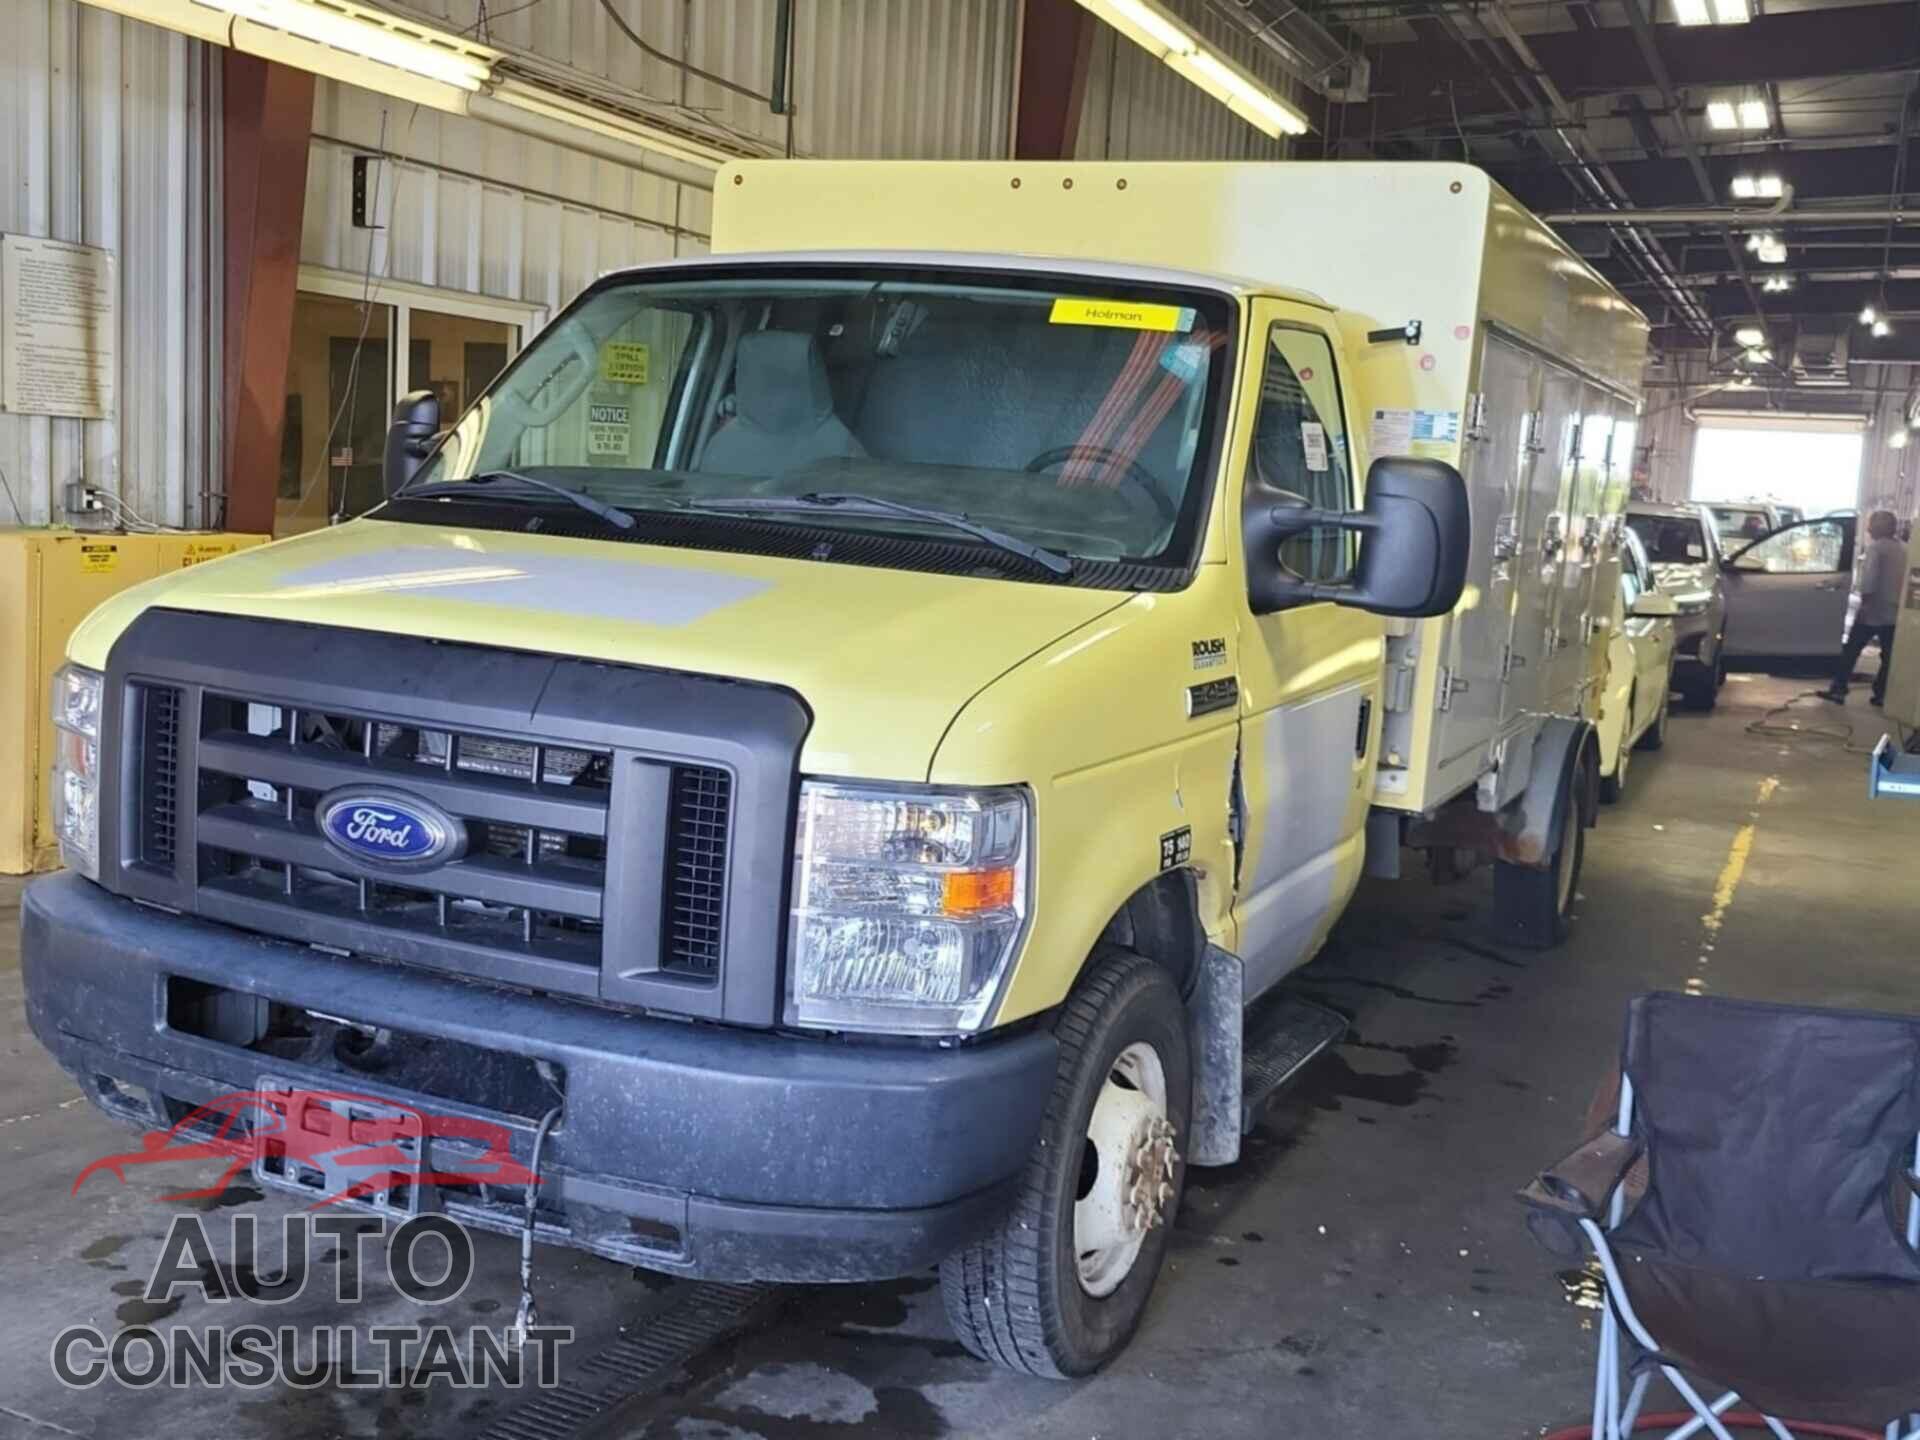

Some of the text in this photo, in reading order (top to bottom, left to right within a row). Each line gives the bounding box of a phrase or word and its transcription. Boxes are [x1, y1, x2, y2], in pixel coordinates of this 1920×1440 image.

[1085, 307, 1143, 322] Holman
[591, 406, 628, 422] NOTICE
[1191, 637, 1226, 656] ROUSH
[347, 807, 412, 848] Ford
